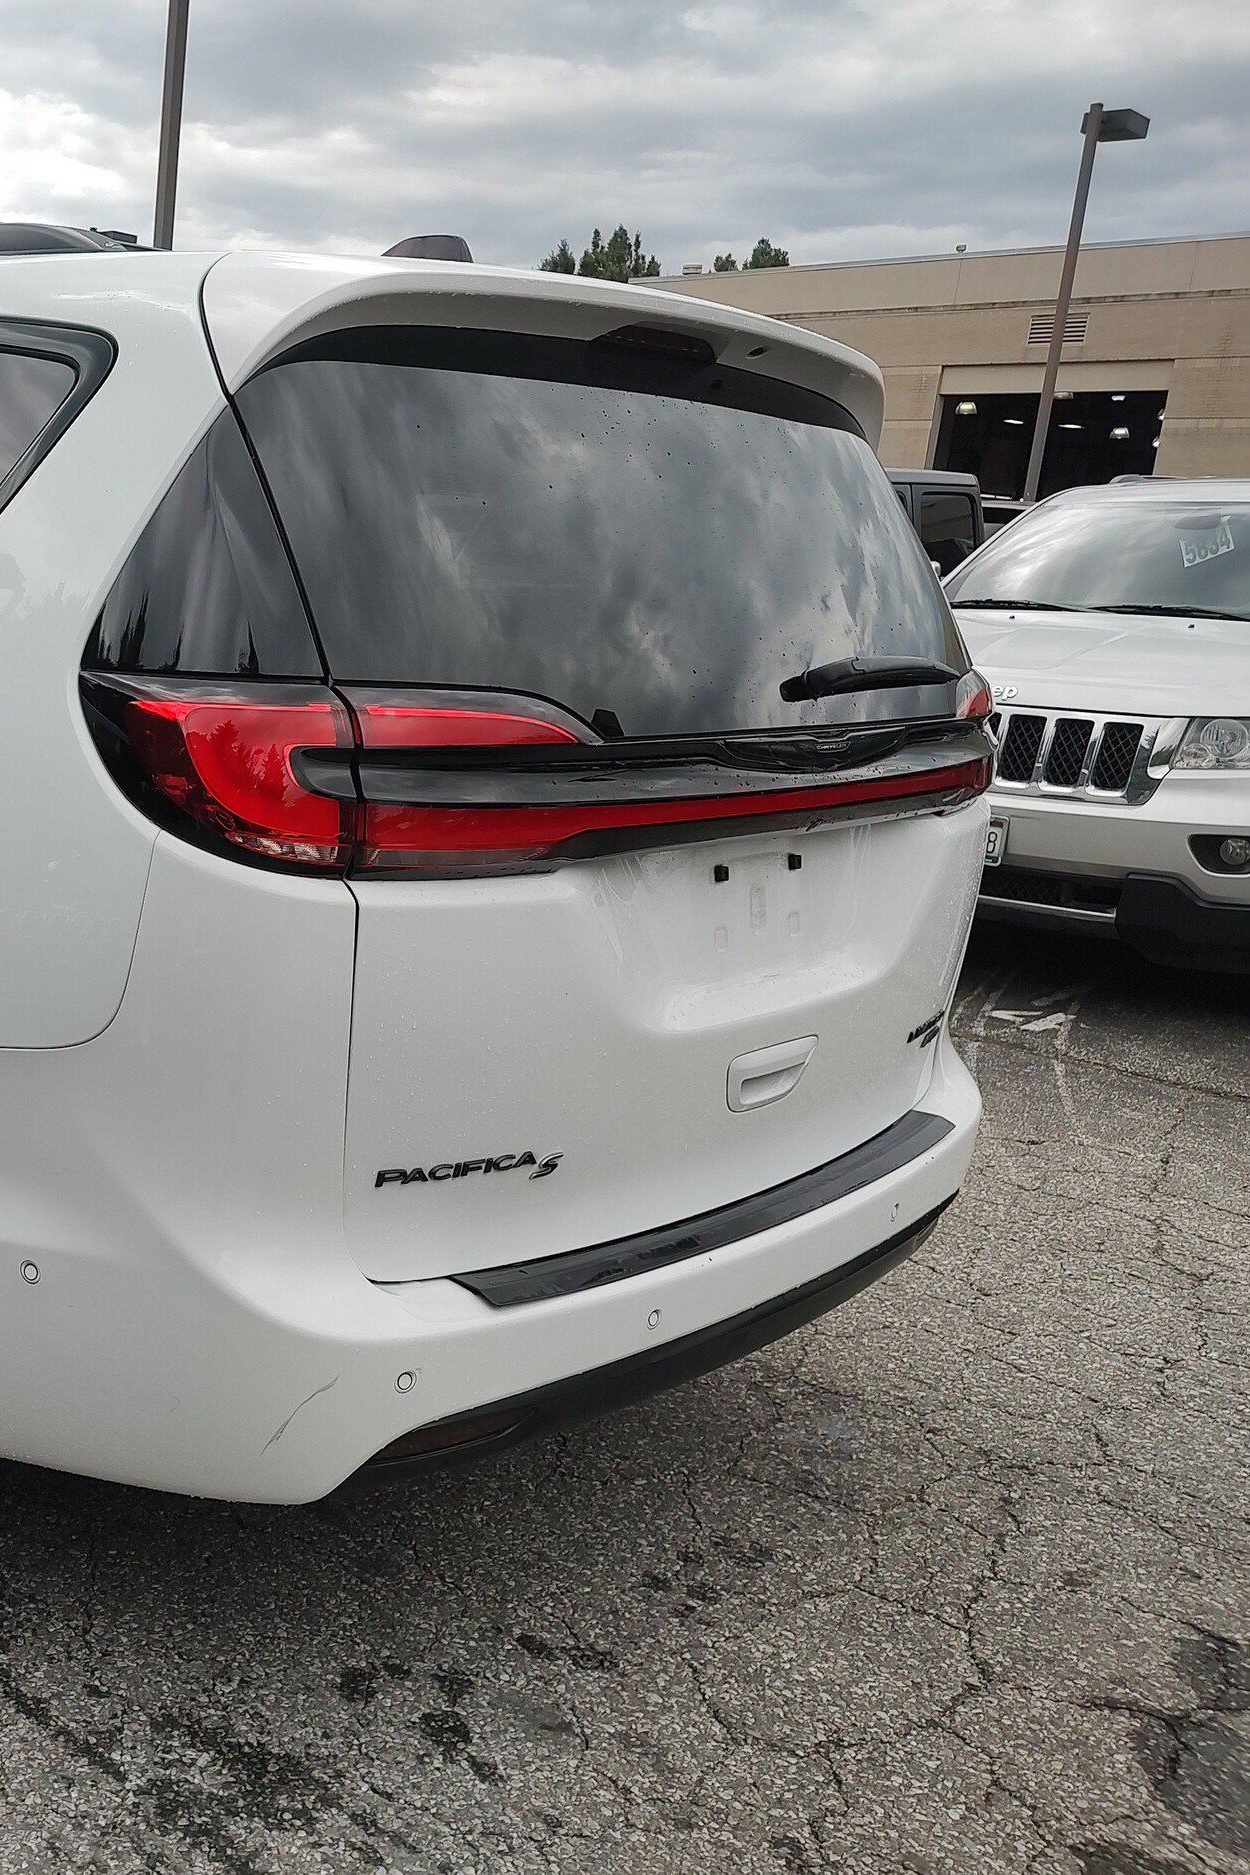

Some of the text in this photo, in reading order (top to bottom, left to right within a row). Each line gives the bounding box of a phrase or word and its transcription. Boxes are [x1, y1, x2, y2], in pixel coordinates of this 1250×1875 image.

[991, 686, 1019, 702] ep
[374, 1150, 565, 1188] PACIFICA S
